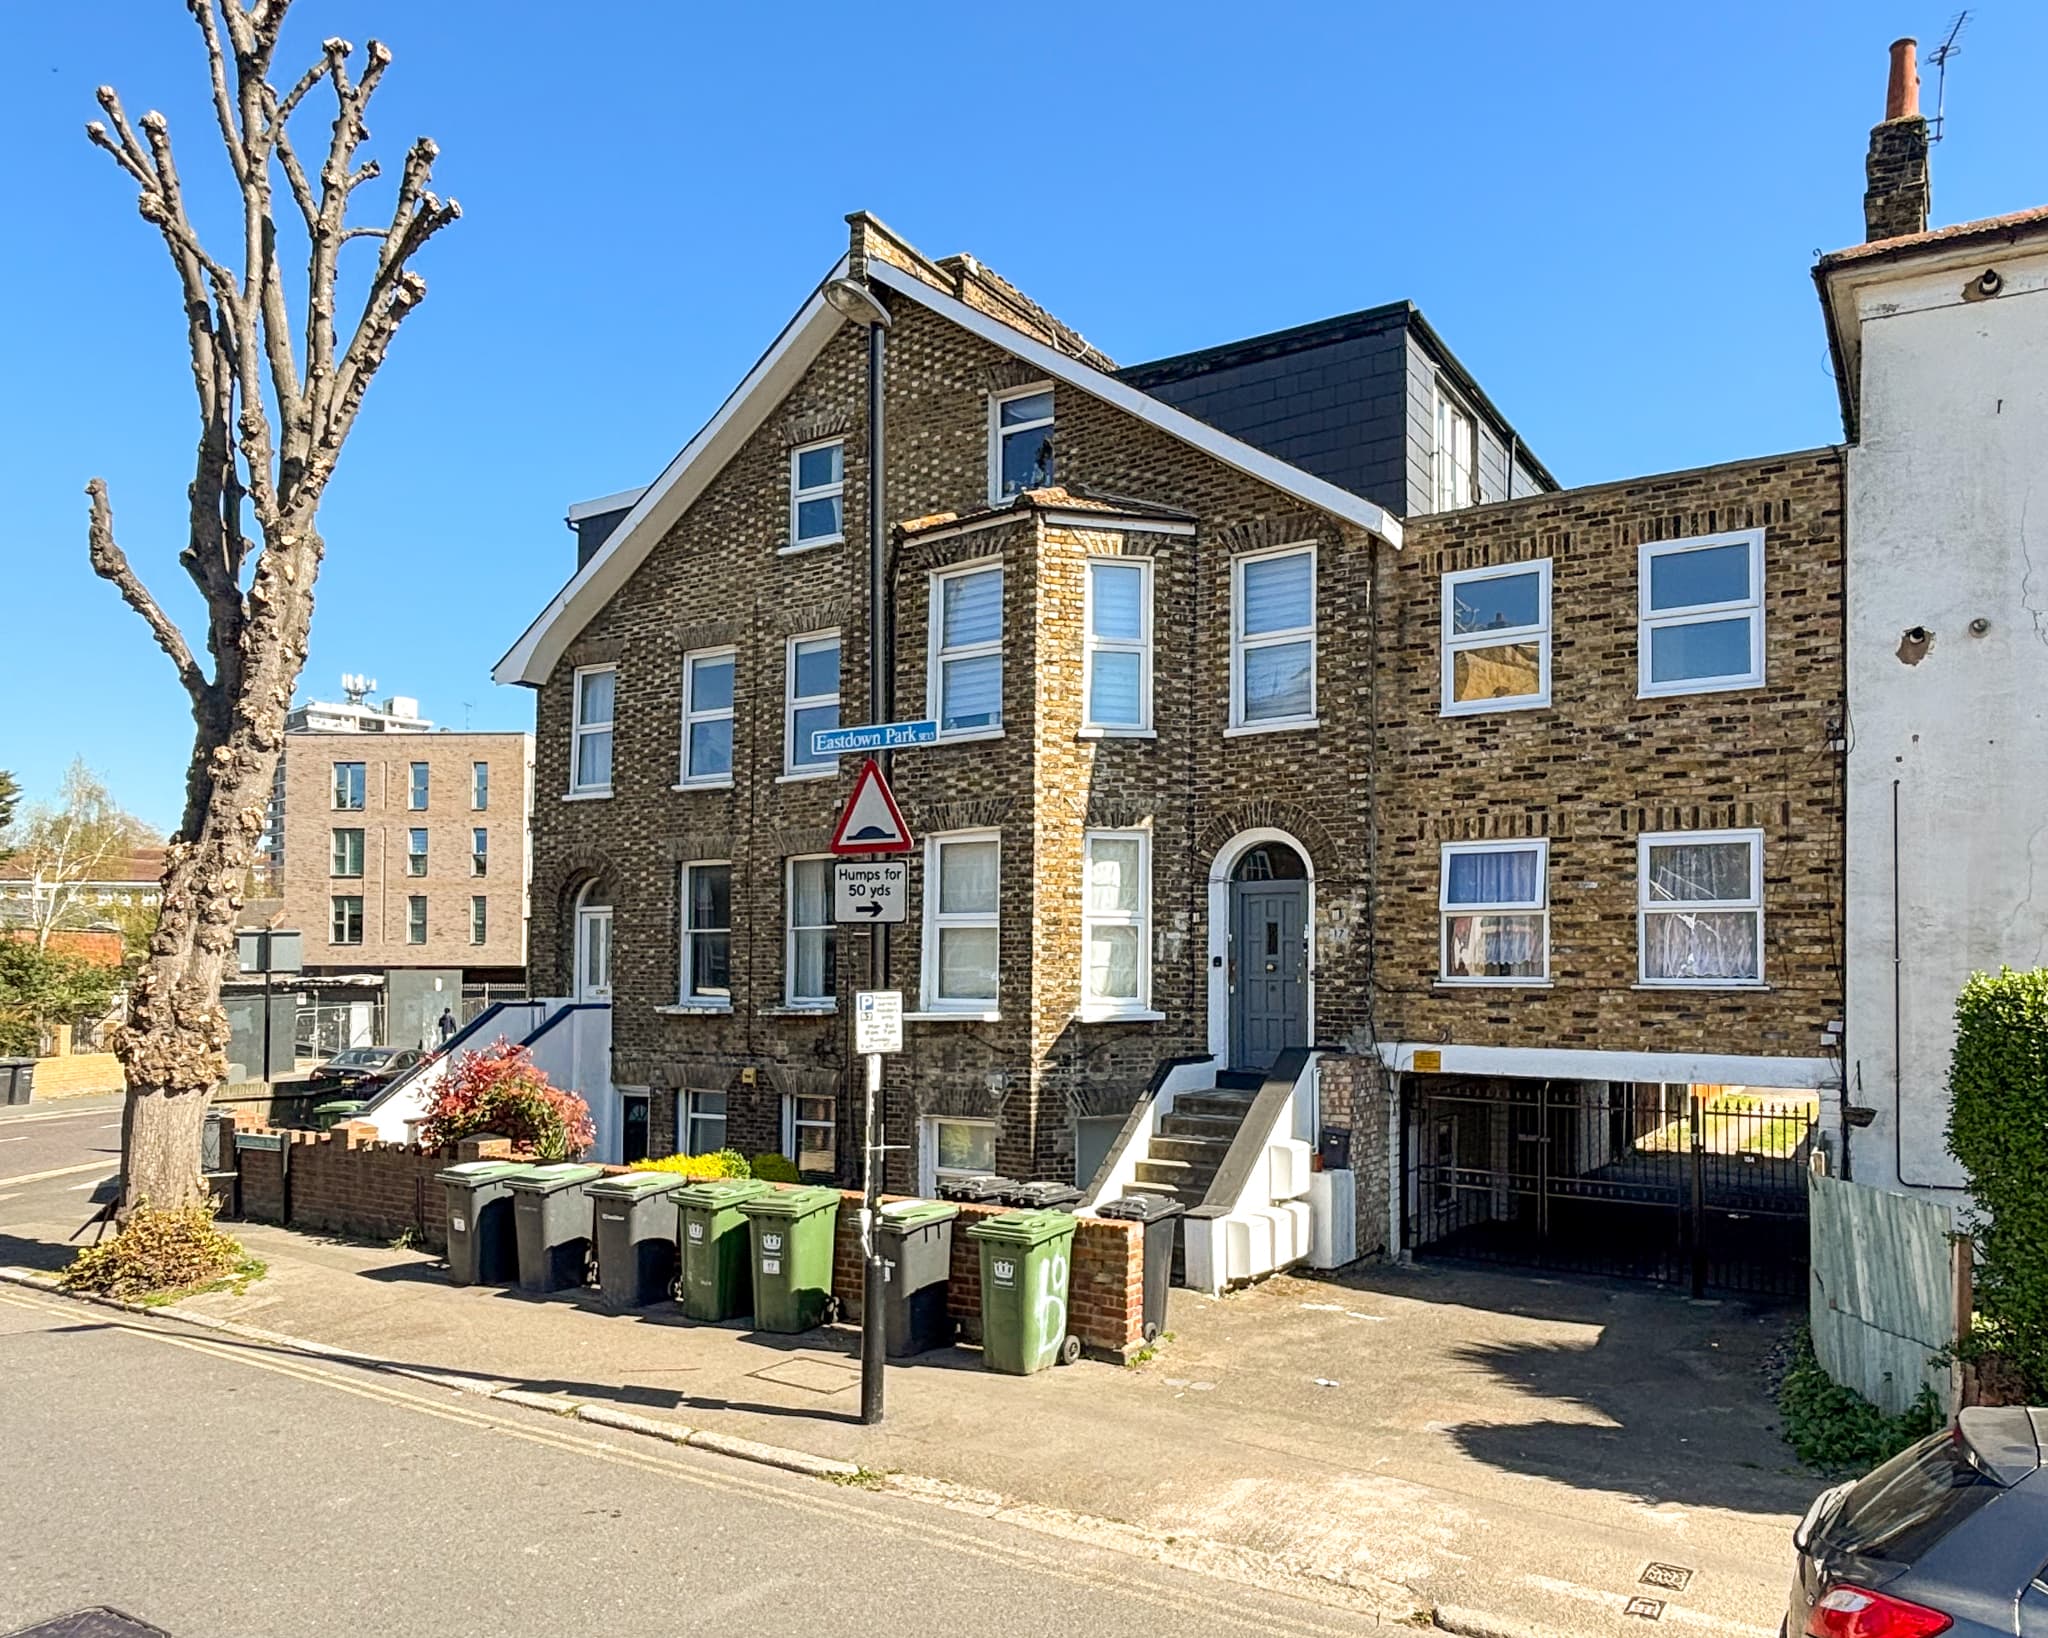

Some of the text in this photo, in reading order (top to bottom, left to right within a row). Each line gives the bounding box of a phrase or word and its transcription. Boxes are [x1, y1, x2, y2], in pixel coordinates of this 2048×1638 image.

[816, 725, 934, 751] Eastdown Park SE13
[839, 868, 902, 883] Humps for
[848, 884, 891, 898] 50 yds
